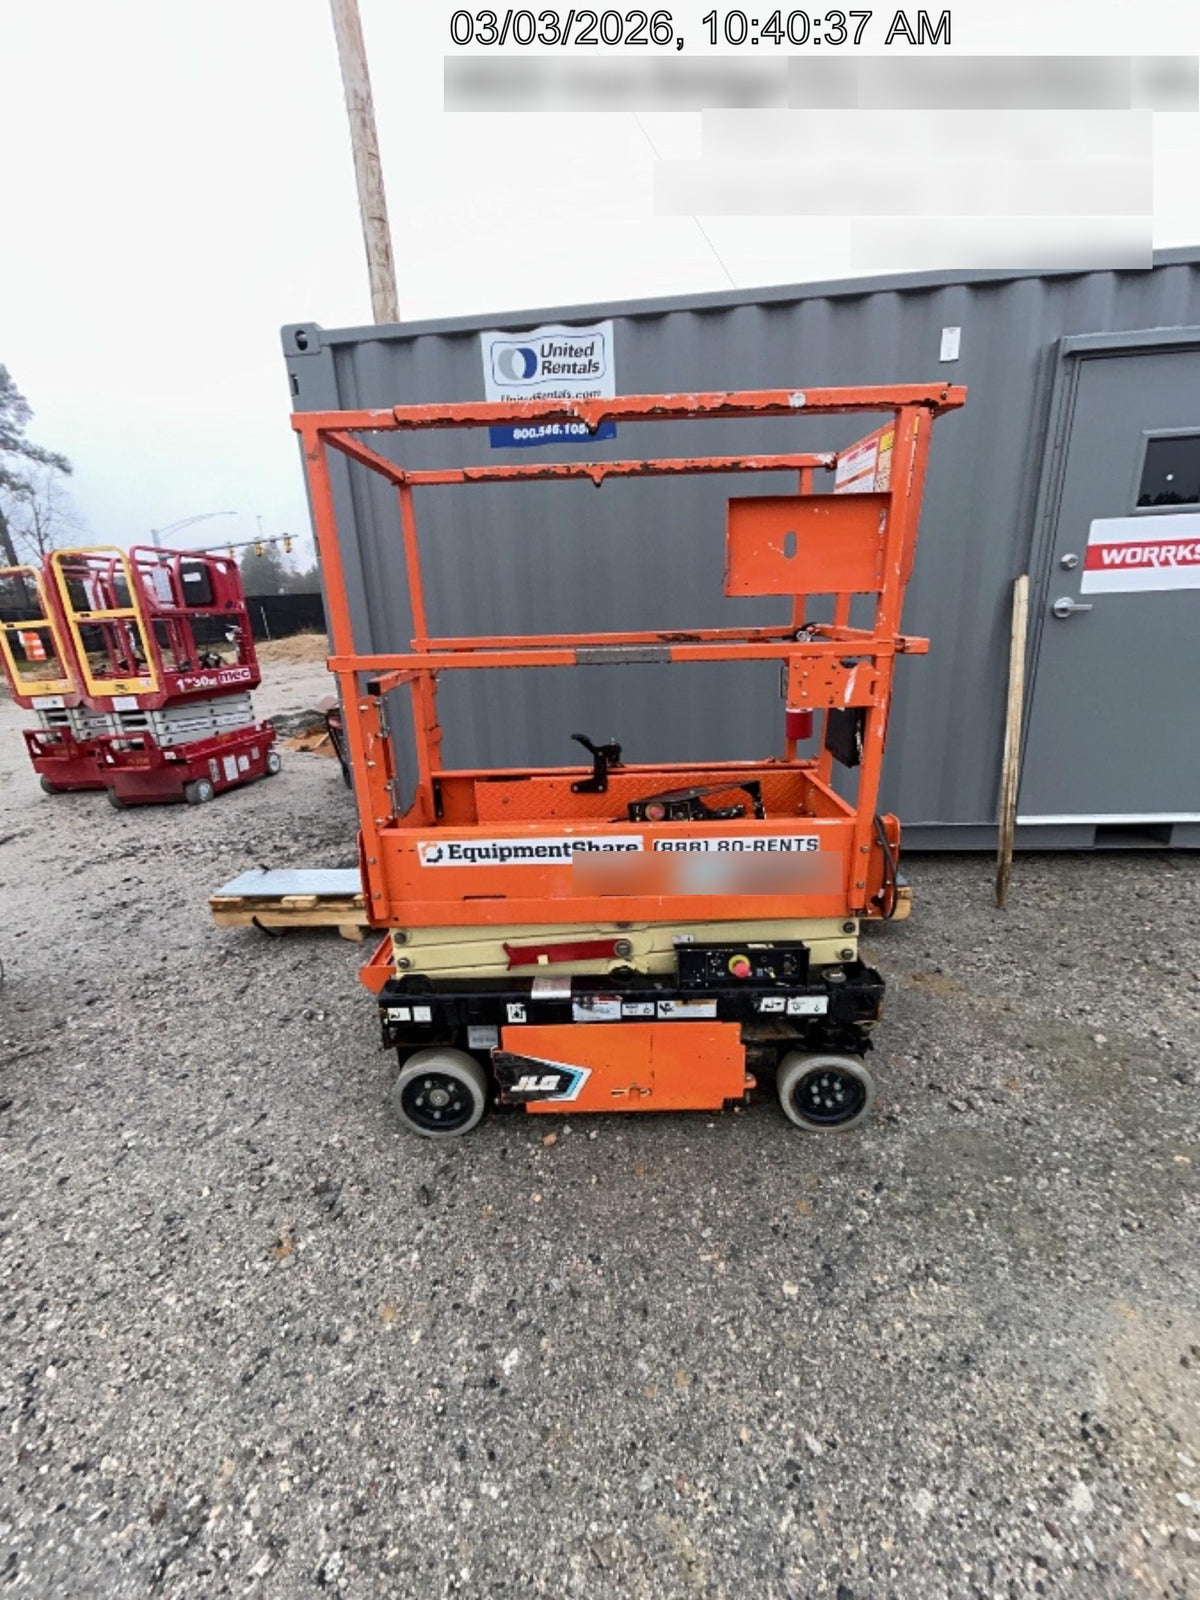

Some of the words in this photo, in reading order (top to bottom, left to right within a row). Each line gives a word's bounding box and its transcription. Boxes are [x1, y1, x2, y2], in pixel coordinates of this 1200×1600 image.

[540, 341, 595, 358] United
[541, 359, 600, 376] Rentals
[447, 840, 639, 862] EquipmentShare
[717, 838, 820, 851] 80-RENTS
[510, 1075, 561, 1092] JLG
